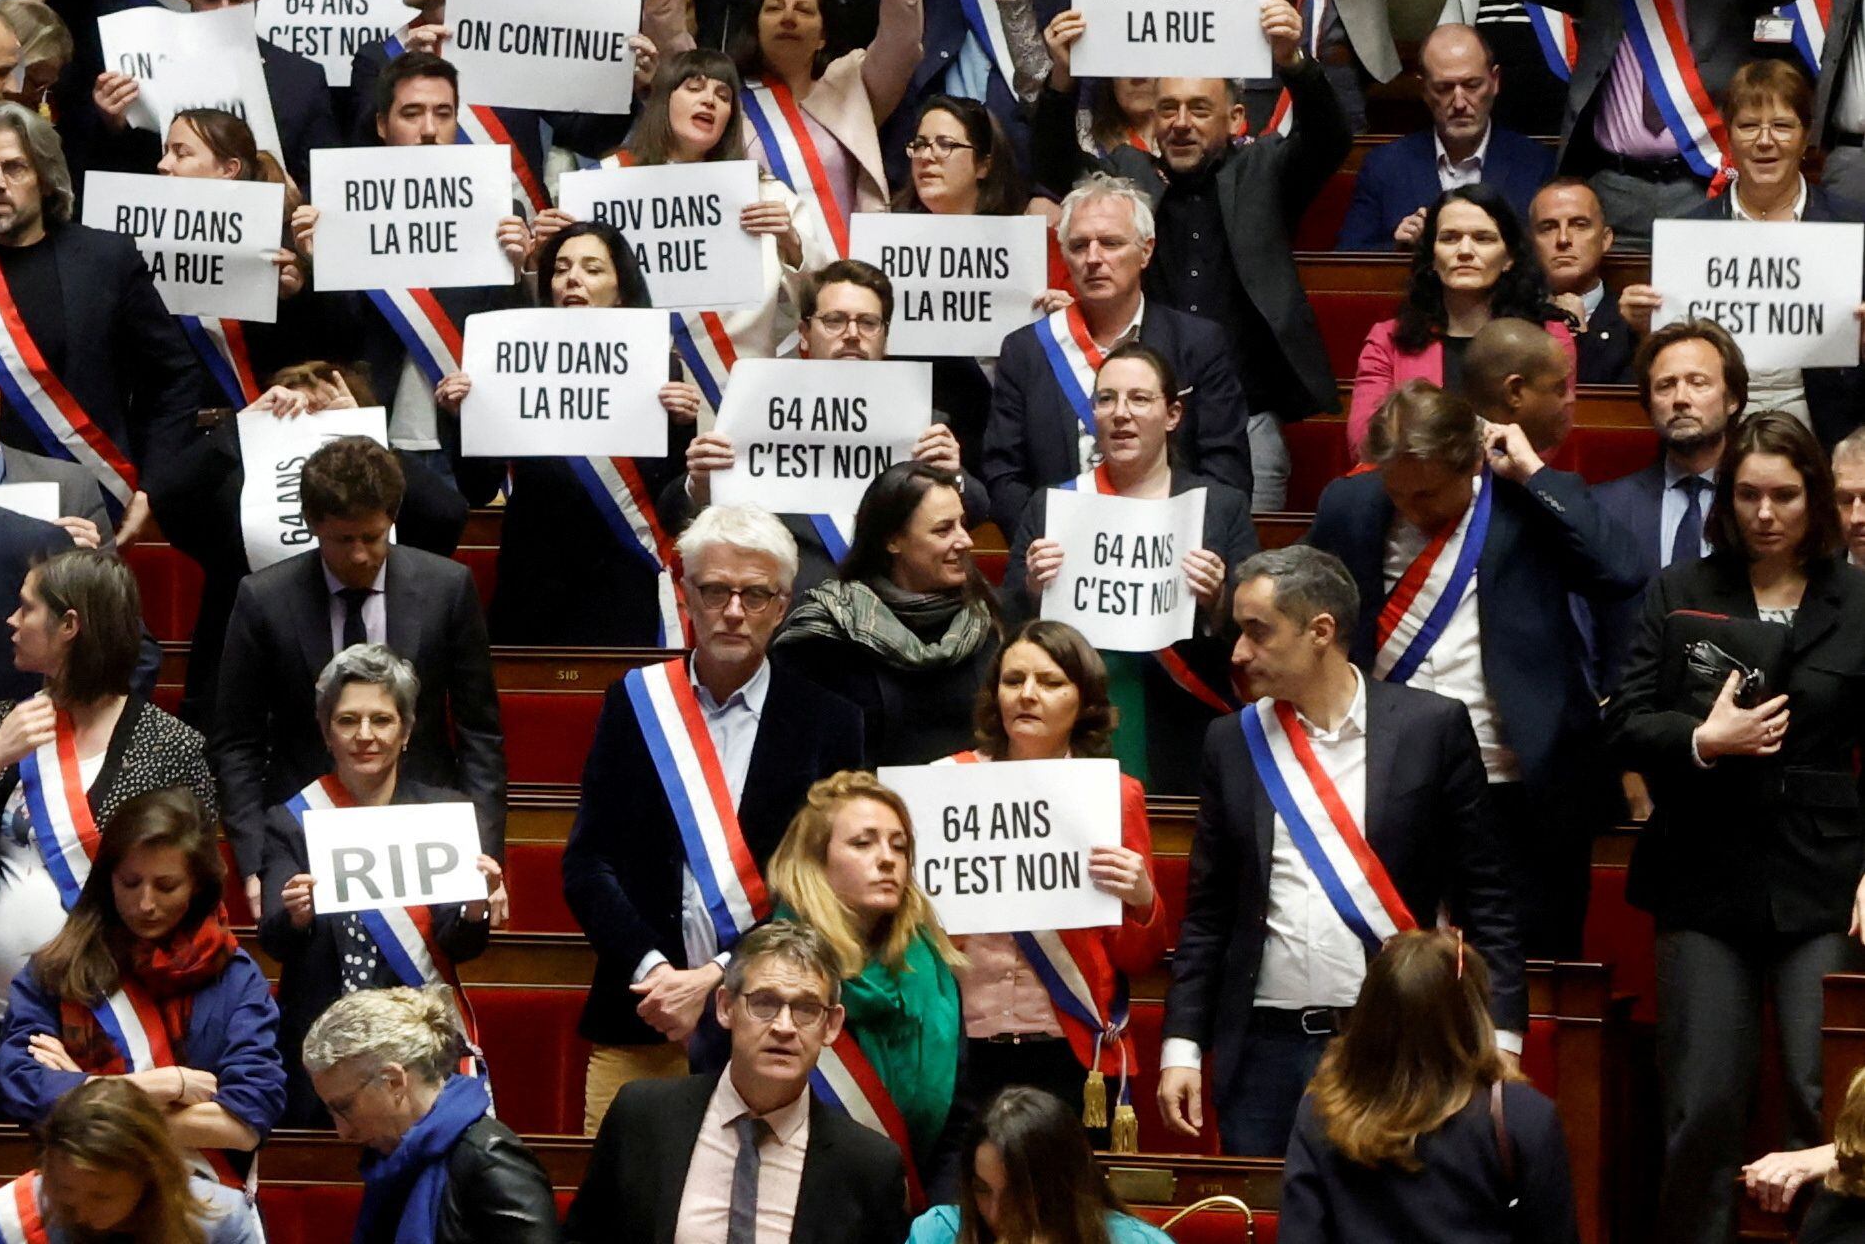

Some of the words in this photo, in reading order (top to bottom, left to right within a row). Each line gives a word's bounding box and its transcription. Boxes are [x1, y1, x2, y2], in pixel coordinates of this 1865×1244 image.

[456, 18, 492, 52] ON
[498, 22, 625, 63] CONTINUE
[1127, 10, 1158, 43] LA
[1165, 10, 1216, 44] RUE
[345, 178, 396, 212] RDV
[404, 176, 474, 210] DANS
[592, 198, 644, 231] RDV
[651, 193, 722, 230] DANS
[115, 204, 168, 239] RDV
[173, 208, 243, 245] DANS
[369, 222, 401, 256] LA
[408, 220, 459, 255] RUE
[174, 252, 225, 286] RUE
[657, 238, 708, 274] RUE
[879, 245, 932, 280] RDV
[939, 246, 1010, 280] DANS
[1707, 256, 1740, 289] 64
[1746, 256, 1801, 290] ANS
[903, 290, 935, 322] LA
[942, 290, 992, 323] RUE
[1768, 302, 1824, 336] NON
[496, 340, 549, 374] RDV
[557, 341, 629, 376] DANS
[519, 386, 551, 420] LA
[559, 386, 610, 421] RUE
[768, 396, 804, 432] 64
[810, 396, 868, 433] ANS
[748, 441, 827, 479] C'EST
[833, 444, 893, 478] NON
[1093, 531, 1125, 567] 64
[1130, 532, 1174, 569] ANS
[1073, 576, 1145, 617] C'EST
[942, 804, 981, 843] 64
[989, 799, 1051, 841] ANS
[331, 842, 460, 903] RIP
[923, 855, 1007, 898] C'EST
[1016, 850, 1081, 892] NON
